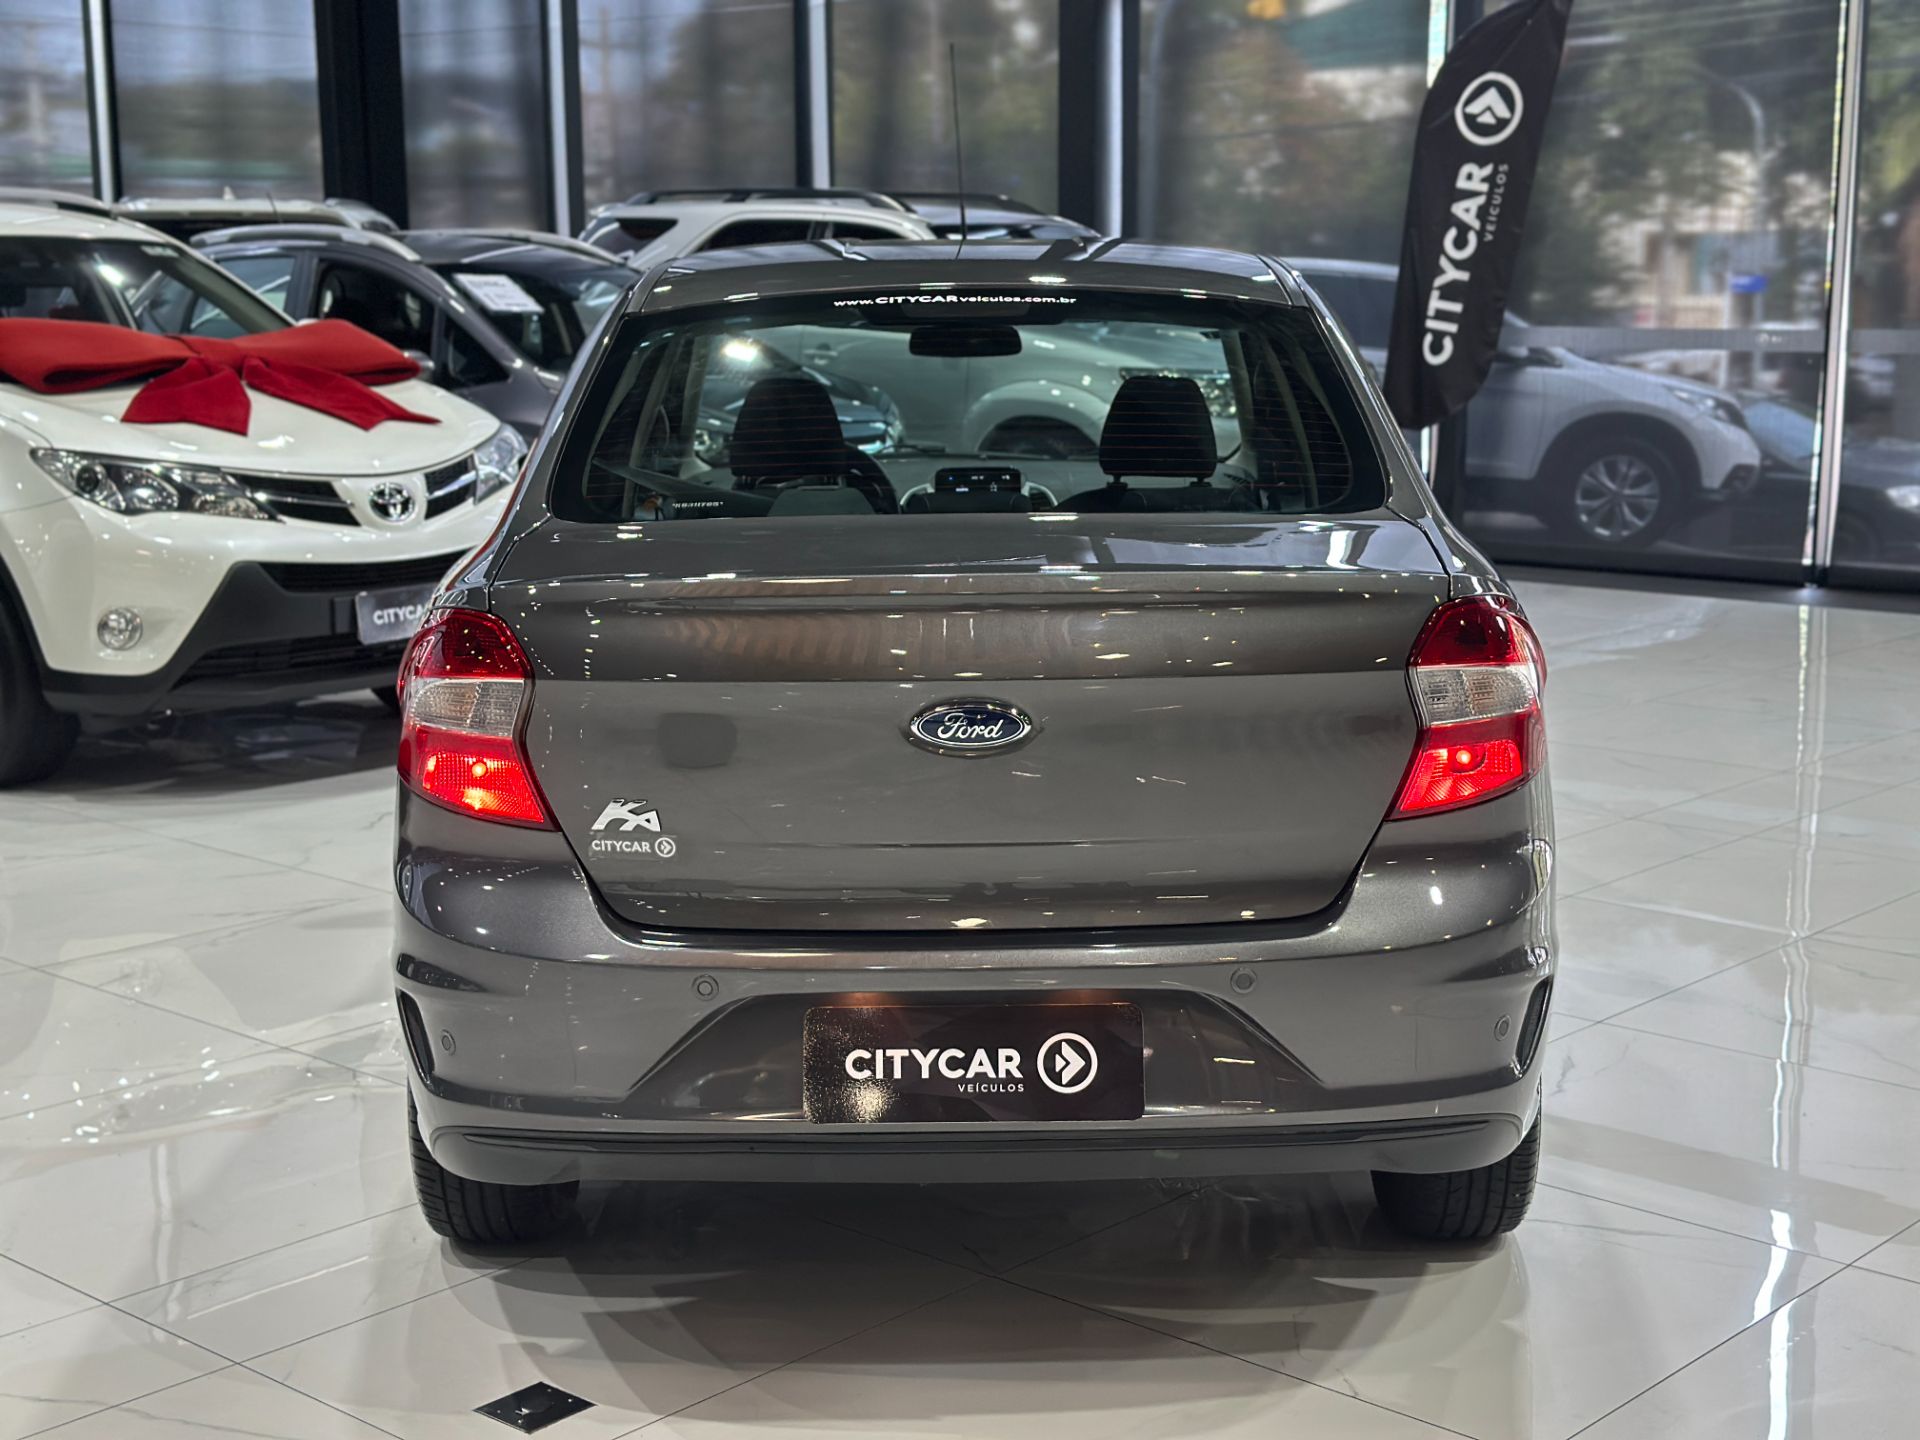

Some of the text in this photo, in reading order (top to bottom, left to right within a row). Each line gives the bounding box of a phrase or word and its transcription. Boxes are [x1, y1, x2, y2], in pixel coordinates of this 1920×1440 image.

[1422, 161, 1494, 366] CITYCAR
[937, 712, 1004, 739] Ford
[591, 839, 652, 853] CITYCAR
[845, 1048, 1024, 1080] CITYCAR
[957, 1082, 1025, 1093] VEÍCULOS
